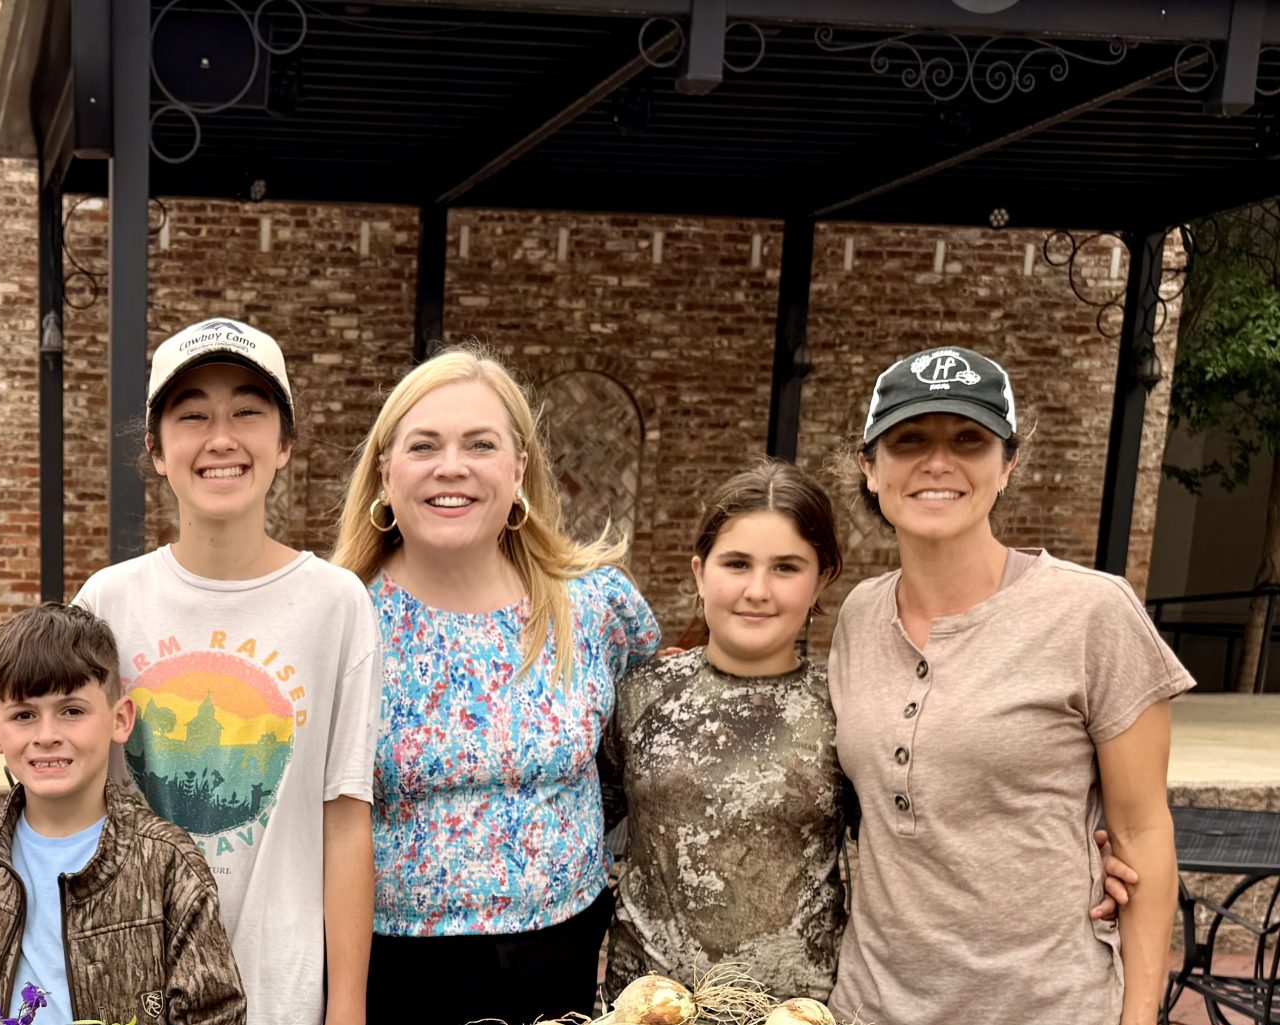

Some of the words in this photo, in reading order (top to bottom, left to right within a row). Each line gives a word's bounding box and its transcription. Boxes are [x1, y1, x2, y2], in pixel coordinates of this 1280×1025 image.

[179, 332, 222, 352] Cowboy
[226, 332, 256, 349] Camo
[210, 631, 307, 727] RAISED
